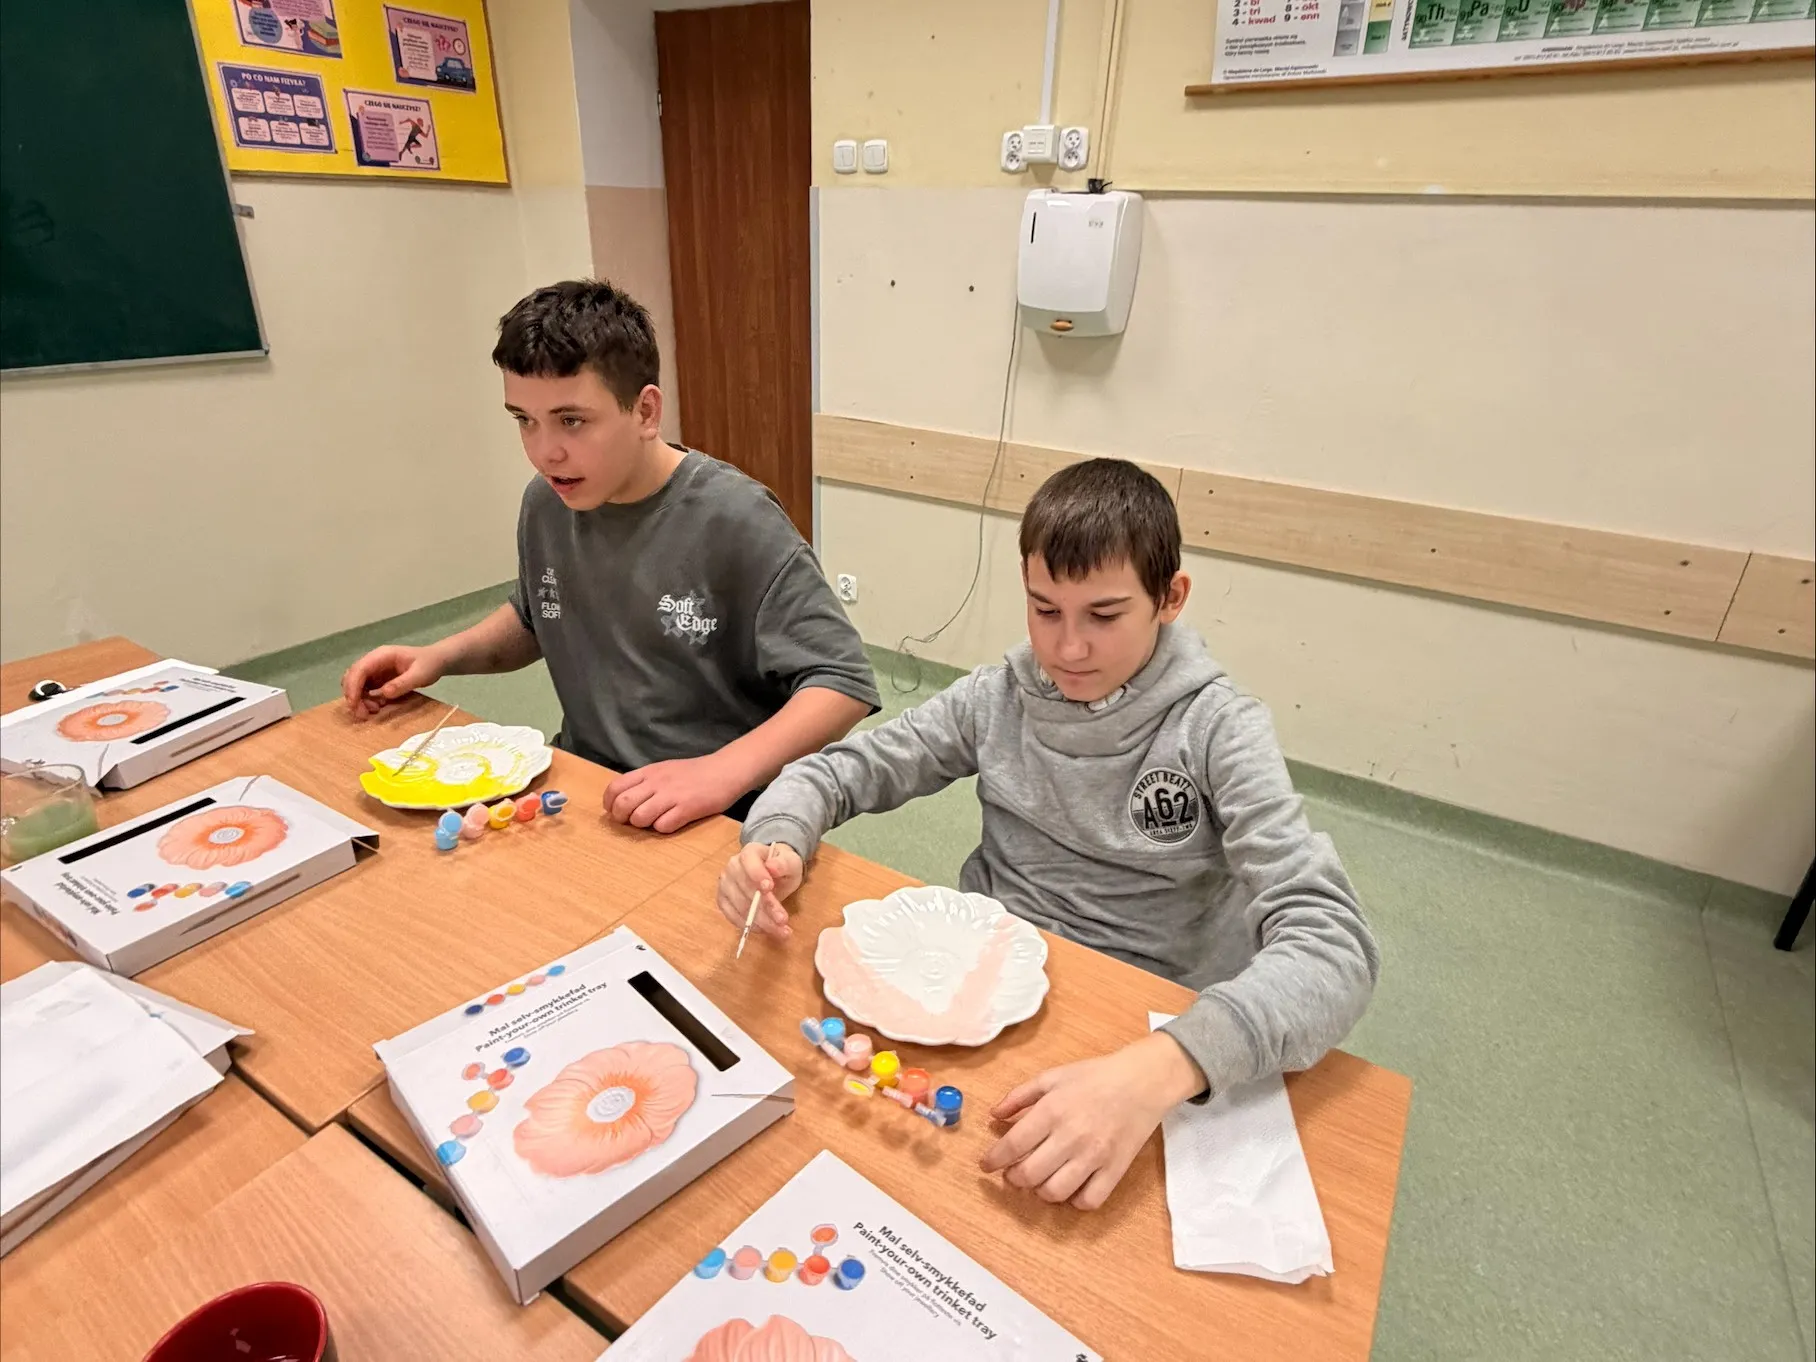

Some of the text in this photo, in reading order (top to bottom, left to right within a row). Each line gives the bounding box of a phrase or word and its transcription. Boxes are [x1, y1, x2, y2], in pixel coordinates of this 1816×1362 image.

[1233, 9, 1240, 17] 3
[1249, 7, 1260, 16] tri
[1285, 4, 1292, 12] 8
[1427, 4, 1445, 21] Th
[1470, 3, 1489, 18] Pa
[1518, 0, 1529, 12] U
[1232, 18, 1239, 26] 4
[1248, 15, 1276, 25] kwad
[1284, 14, 1291, 22] 9
[241, 72, 252, 81] PO
[253, 74, 263, 82] CO
[656, 594, 695, 614] Soft
[676, 614, 718, 635] Edge
[1134, 772, 1161, 800] STREET
[1143, 787, 1194, 829] A62
[475, 1009, 554, 1052] Paint-your-own
[554, 991, 588, 1011] trinket
[588, 981, 608, 994] tray
[488, 1022, 510, 1037] Mal
[511, 984, 587, 1026] selv-smykkefad
[878, 1225, 988, 1312] Mal selv-smykkefad
[853, 1221, 998, 1341] Paint-your-own trinket tray
